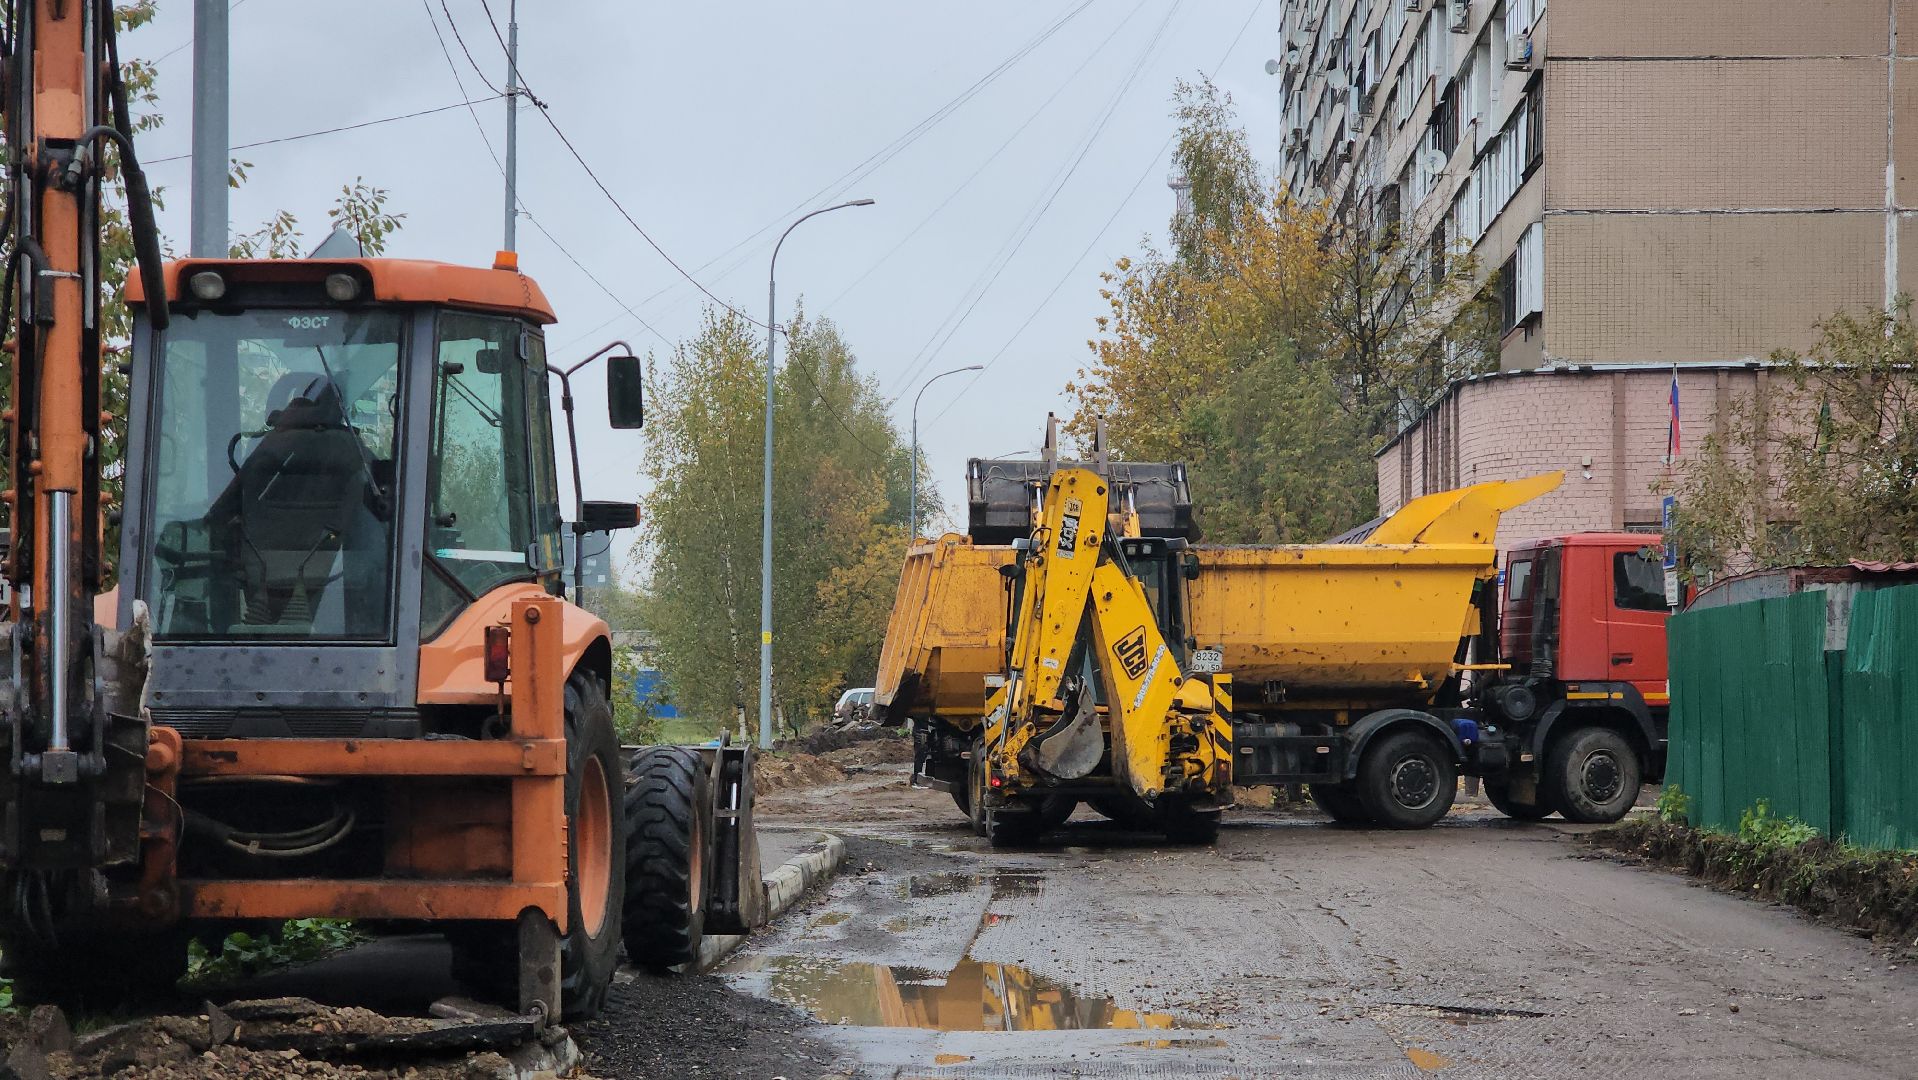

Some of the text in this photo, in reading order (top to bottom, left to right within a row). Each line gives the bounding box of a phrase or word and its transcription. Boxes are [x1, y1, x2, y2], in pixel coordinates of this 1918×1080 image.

[288, 316, 329, 328] ФЭСТ
[1117, 633, 1146, 677] JCB
[1196, 652, 1219, 661] 8232
